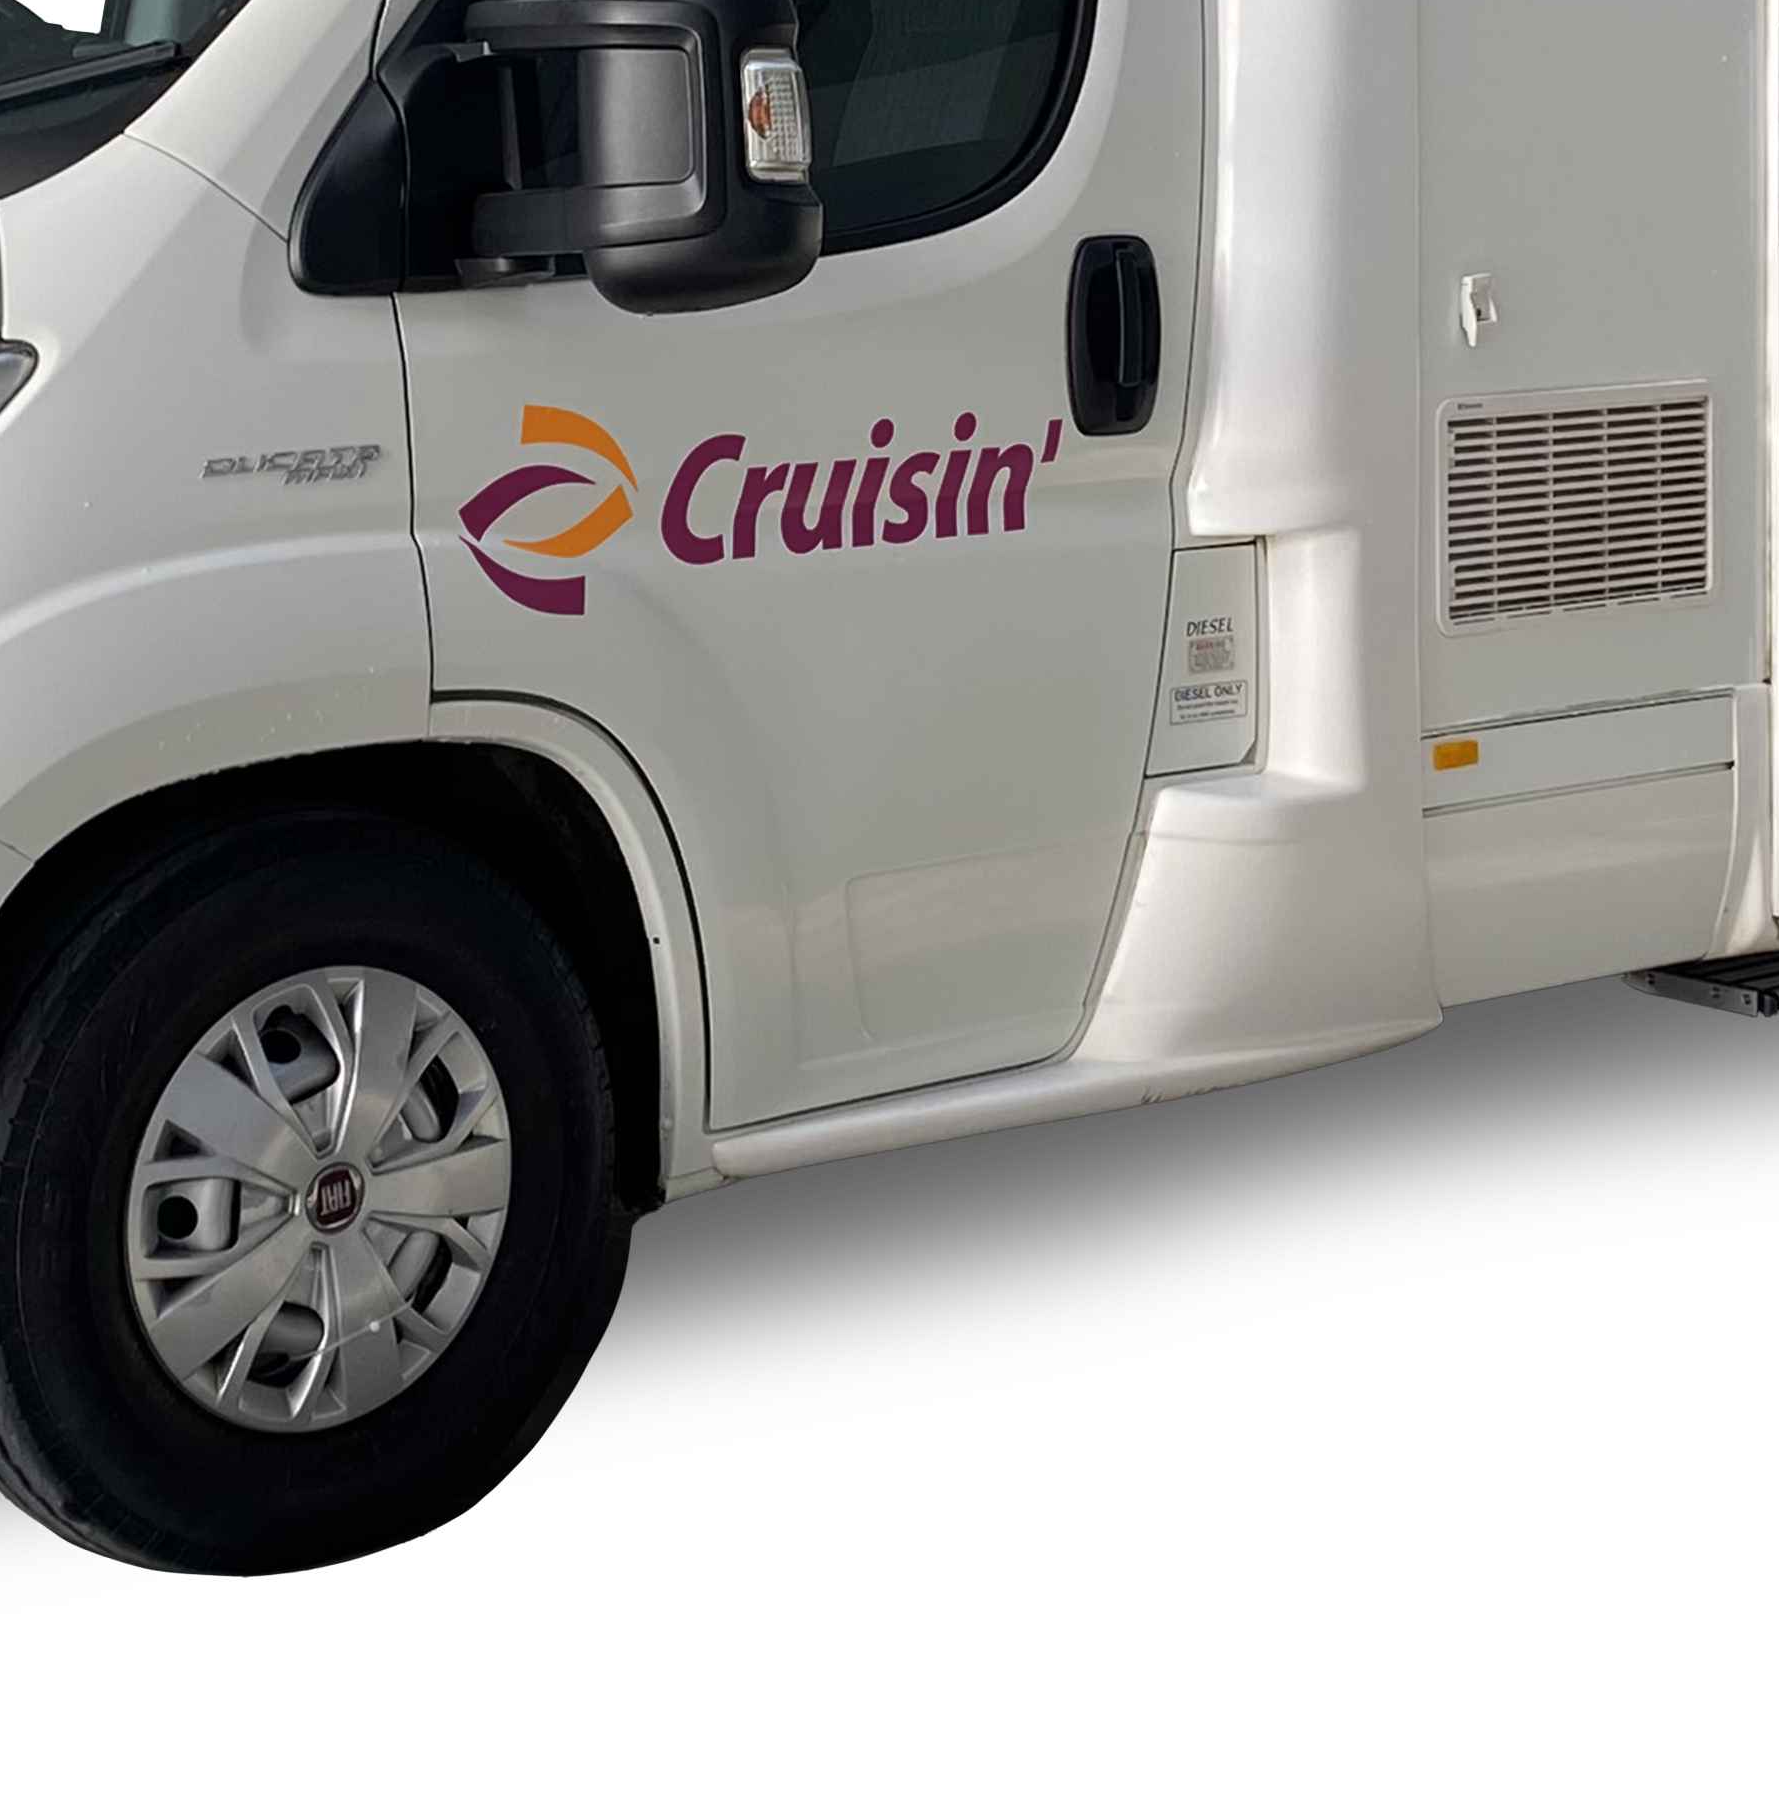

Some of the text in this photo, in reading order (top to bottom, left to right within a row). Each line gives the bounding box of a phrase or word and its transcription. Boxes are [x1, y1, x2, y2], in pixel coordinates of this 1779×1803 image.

[660, 411, 1063, 566] Cruisin'
[1186, 617, 1234, 637] DIESEL
[1174, 683, 1243, 702] DIESEL ONLY
[319, 1178, 352, 1217] FIAT
